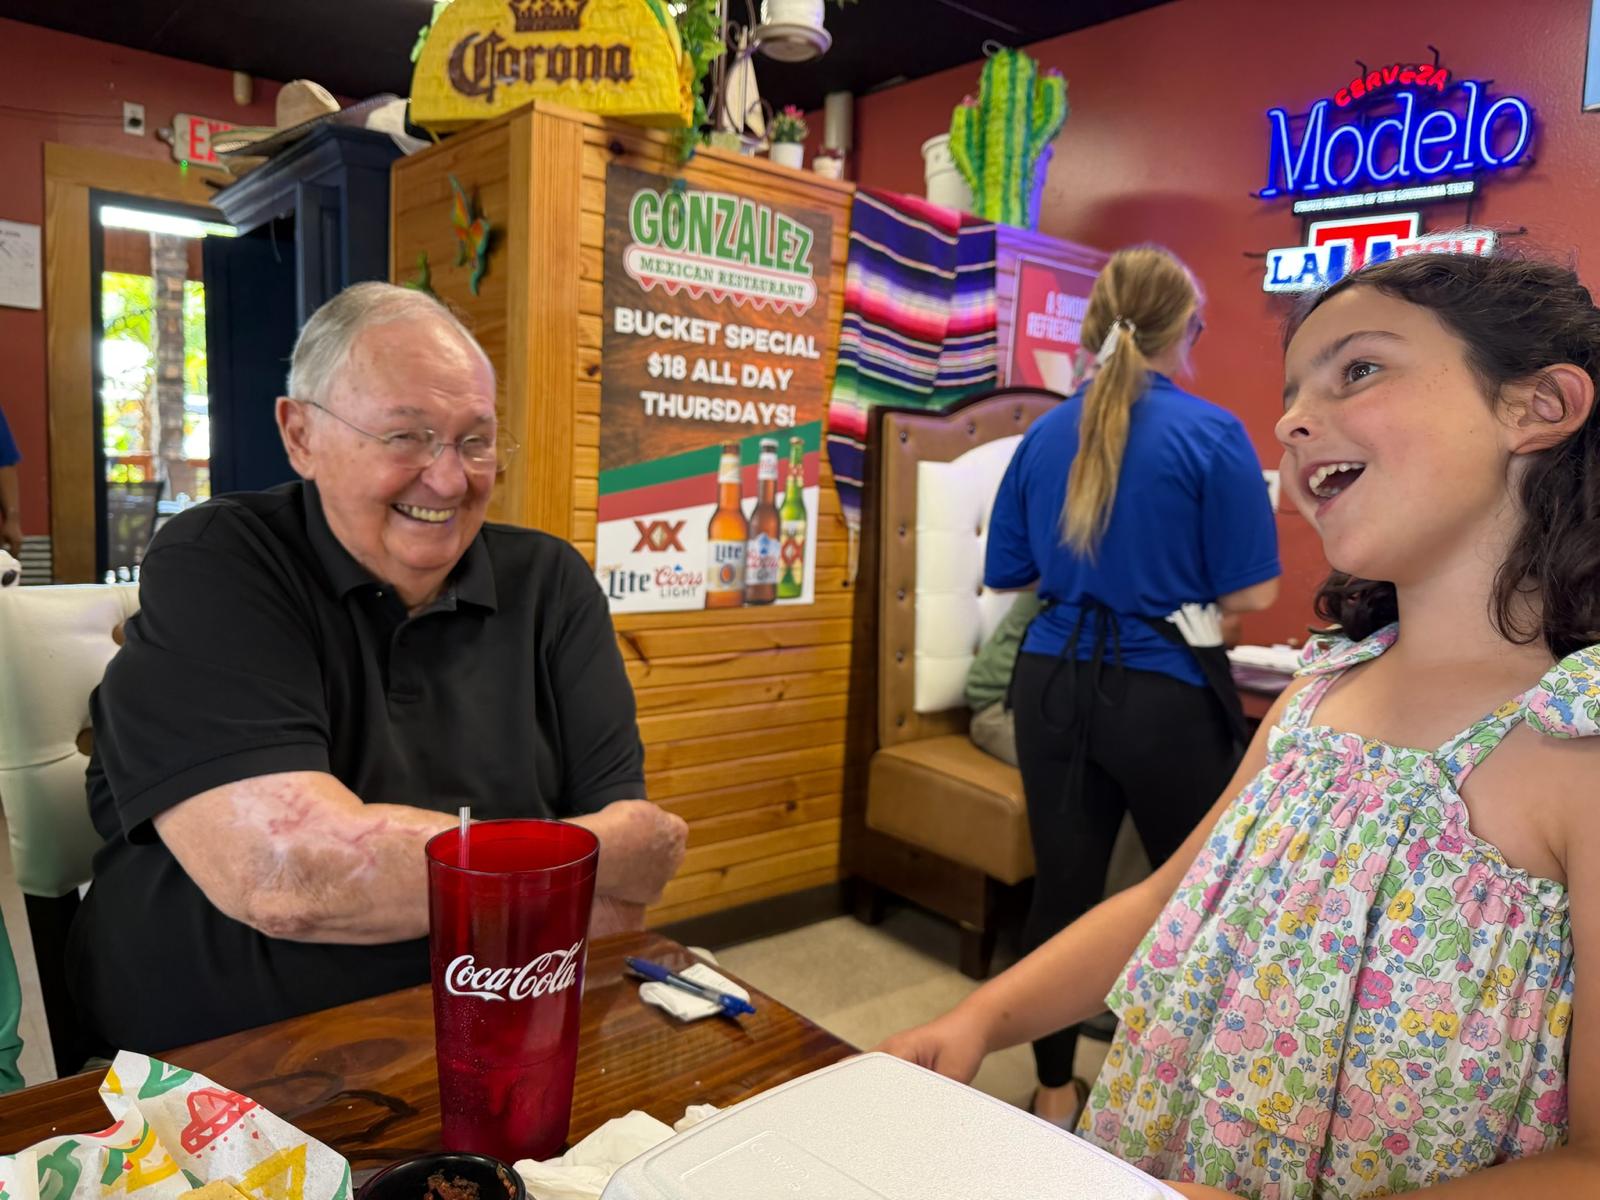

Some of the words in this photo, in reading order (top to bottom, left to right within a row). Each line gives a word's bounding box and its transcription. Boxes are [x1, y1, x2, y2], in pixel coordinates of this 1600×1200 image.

[448, 29, 634, 104] Corona
[1259, 79, 1530, 197] Modelo
[630, 189, 812, 275] GONZALEZ
[639, 255, 714, 284] MEXICAN
[717, 268, 806, 299] RESTAURANT
[614, 306, 721, 346] BUCKET
[724, 323, 821, 360] SPECIAL
[647, 350, 687, 381] $18
[691, 357, 738, 387] ALL
[741, 363, 794, 392] DAY
[640, 390, 797, 428] THURSDAYS!
[632, 520, 687, 553] XX
[715, 544, 742, 563] Lite
[608, 570, 650, 600] Lite
[655, 564, 704, 587] Coors
[660, 586, 697, 599] LIGHT
[445, 938, 585, 1001] Coca-Cola
